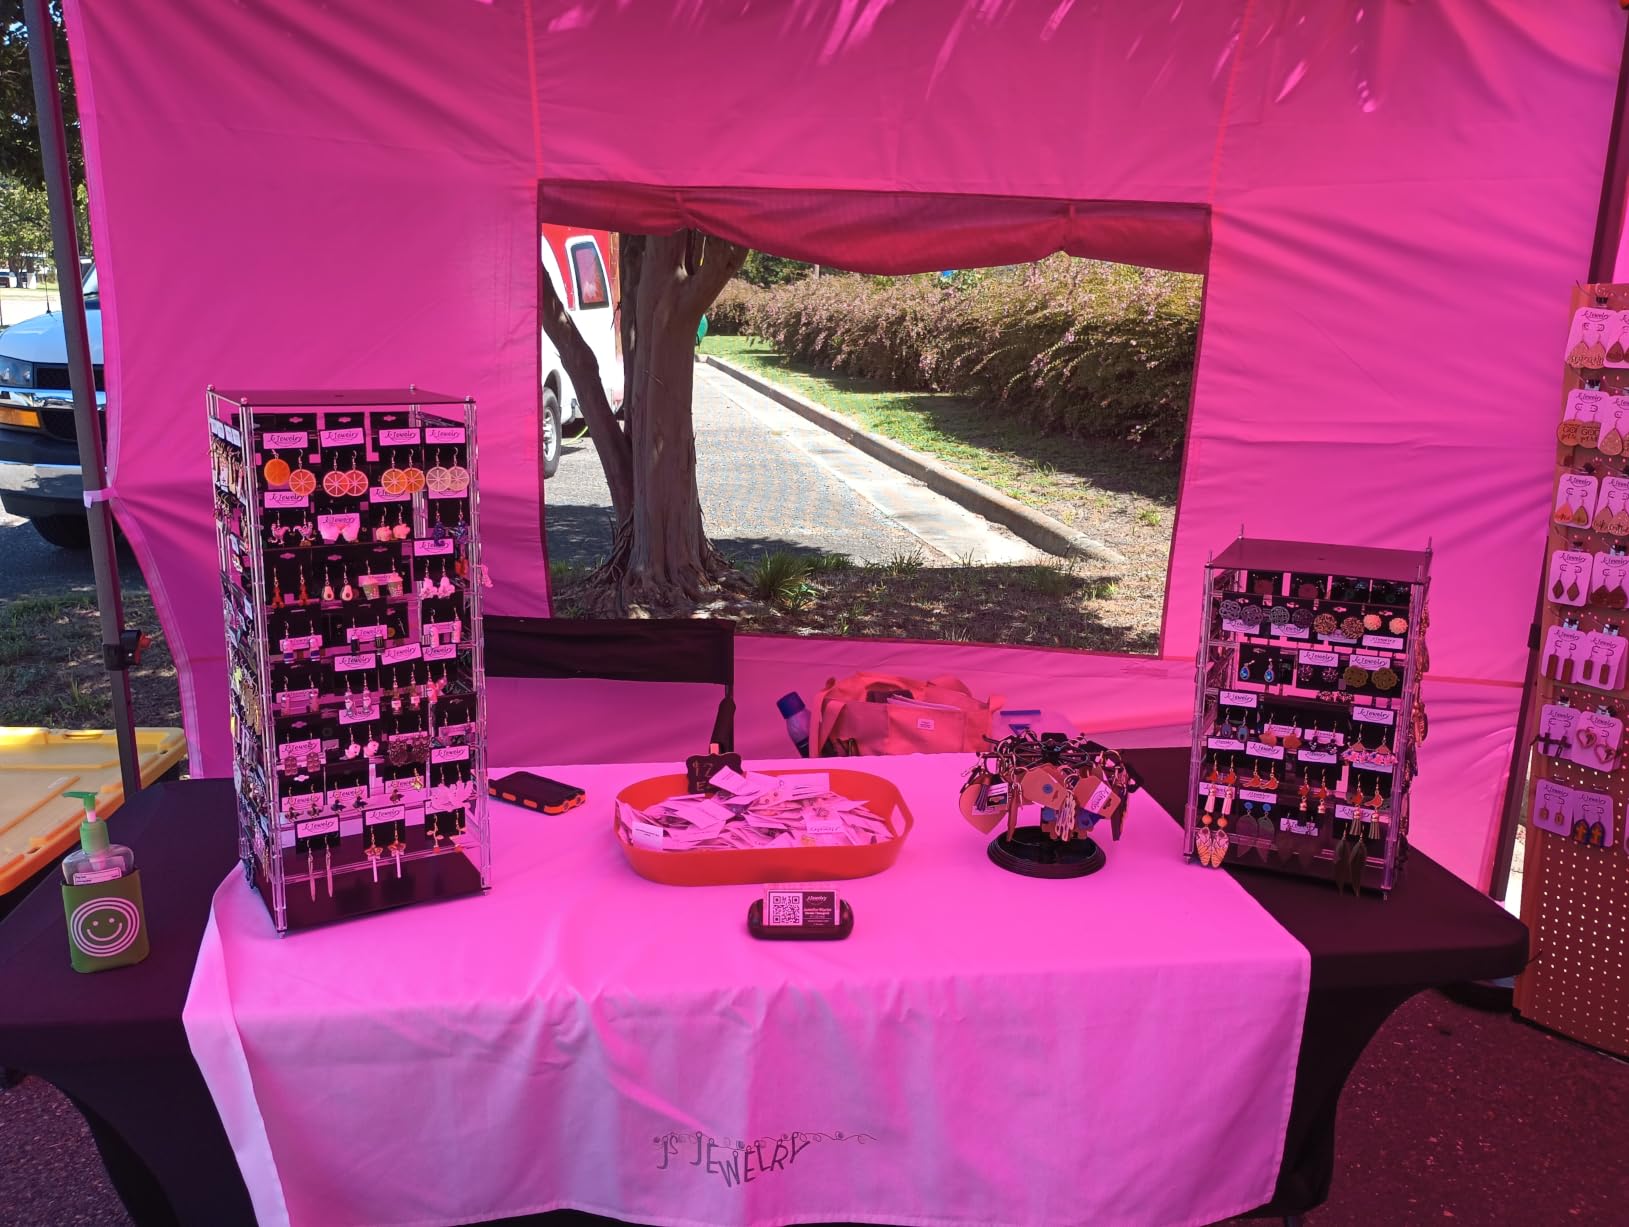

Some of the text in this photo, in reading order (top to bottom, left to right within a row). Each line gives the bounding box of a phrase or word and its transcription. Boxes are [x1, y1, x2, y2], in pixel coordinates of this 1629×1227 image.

[276, 434, 302, 442] Jewelry
[335, 431, 359, 439] Jewelry
[393, 430, 416, 438] Jewelry
[279, 493, 304, 501] Jewelry
[393, 646, 416, 656] Jewelry
[431, 646, 453, 655] Jewelry
[1311, 652, 1334, 661] Jewelry
[1360, 658, 1387, 667] Jewelry
[1232, 694, 1253, 702] Jewelry
[1366, 711, 1390, 719] Jewelry
[443, 748, 466, 757] Jewelry
[310, 819, 335, 829] Jewelry
[689, 1131, 811, 1188] JEWELRY
